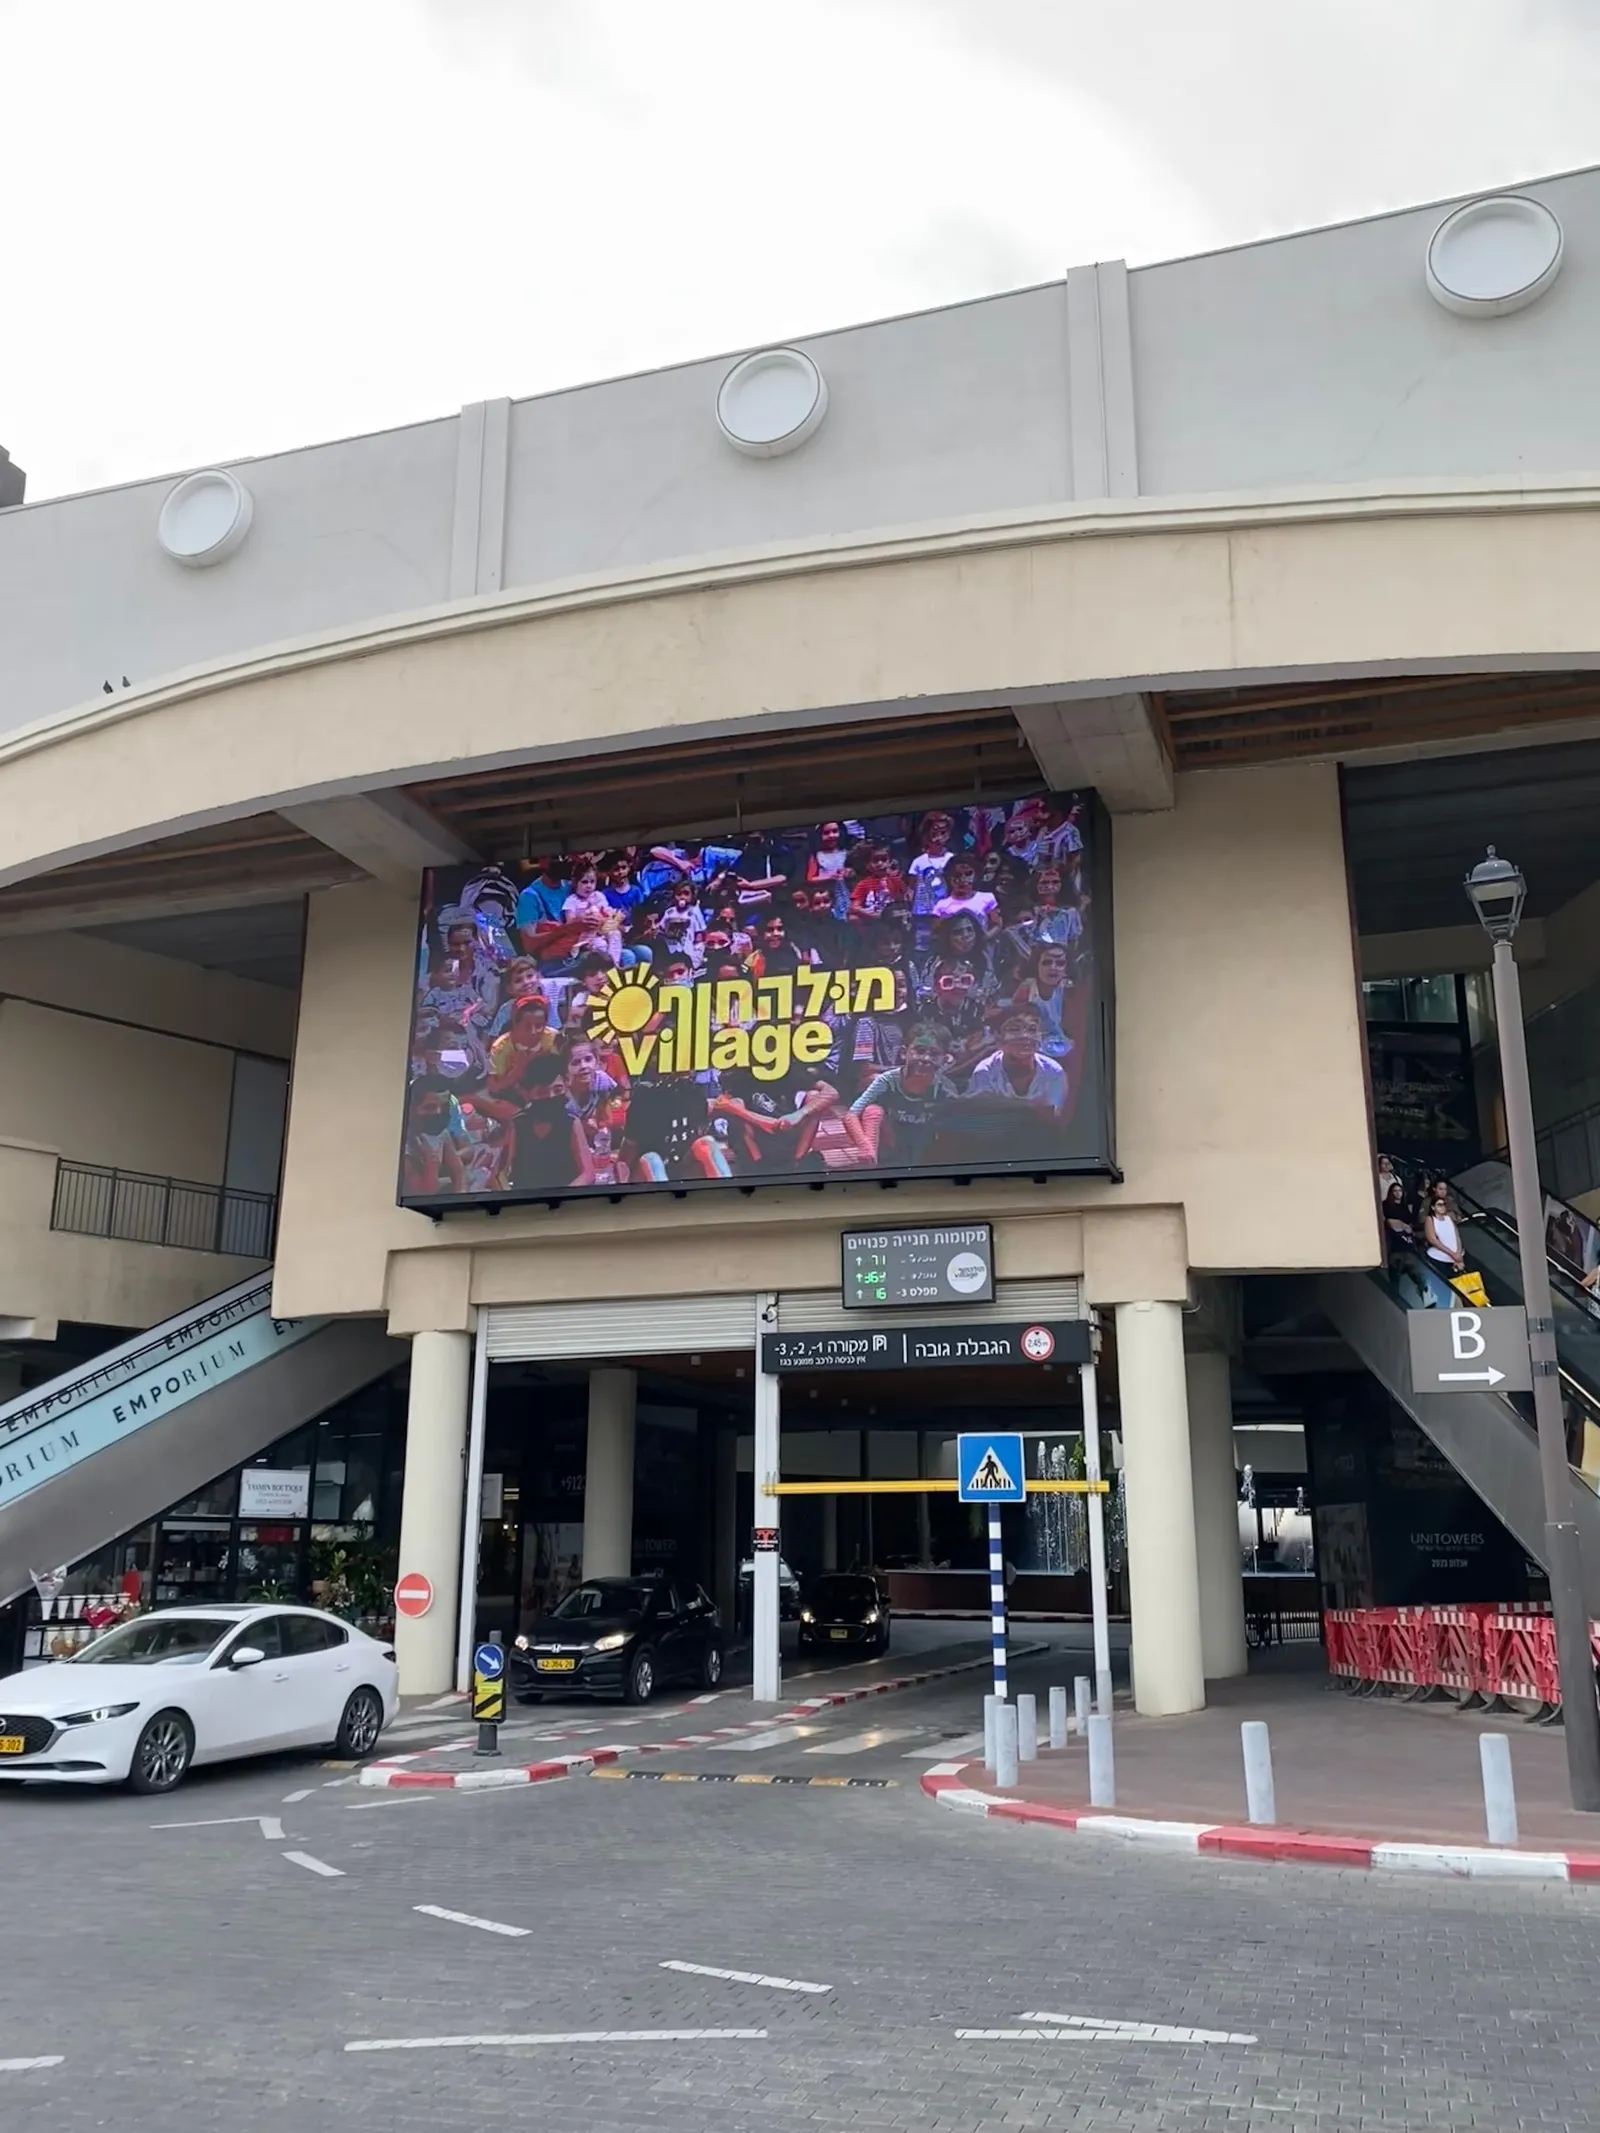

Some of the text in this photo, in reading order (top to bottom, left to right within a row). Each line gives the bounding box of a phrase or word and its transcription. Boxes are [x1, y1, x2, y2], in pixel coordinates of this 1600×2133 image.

[618, 1012, 834, 1082] village
[847, 1229, 987, 1250] מקומות חנייה פנויים
[910, 1286, 938, 1297] מפלס
[1450, 1311, 1486, 1360] B
[827, 1339, 869, 1356] מקורה
[915, 1337, 1011, 1358] הגבלת גובה
[112, 1340, 247, 1424] EMPORIUM
[1410, 1532, 1485, 1545] UNITOWERS
